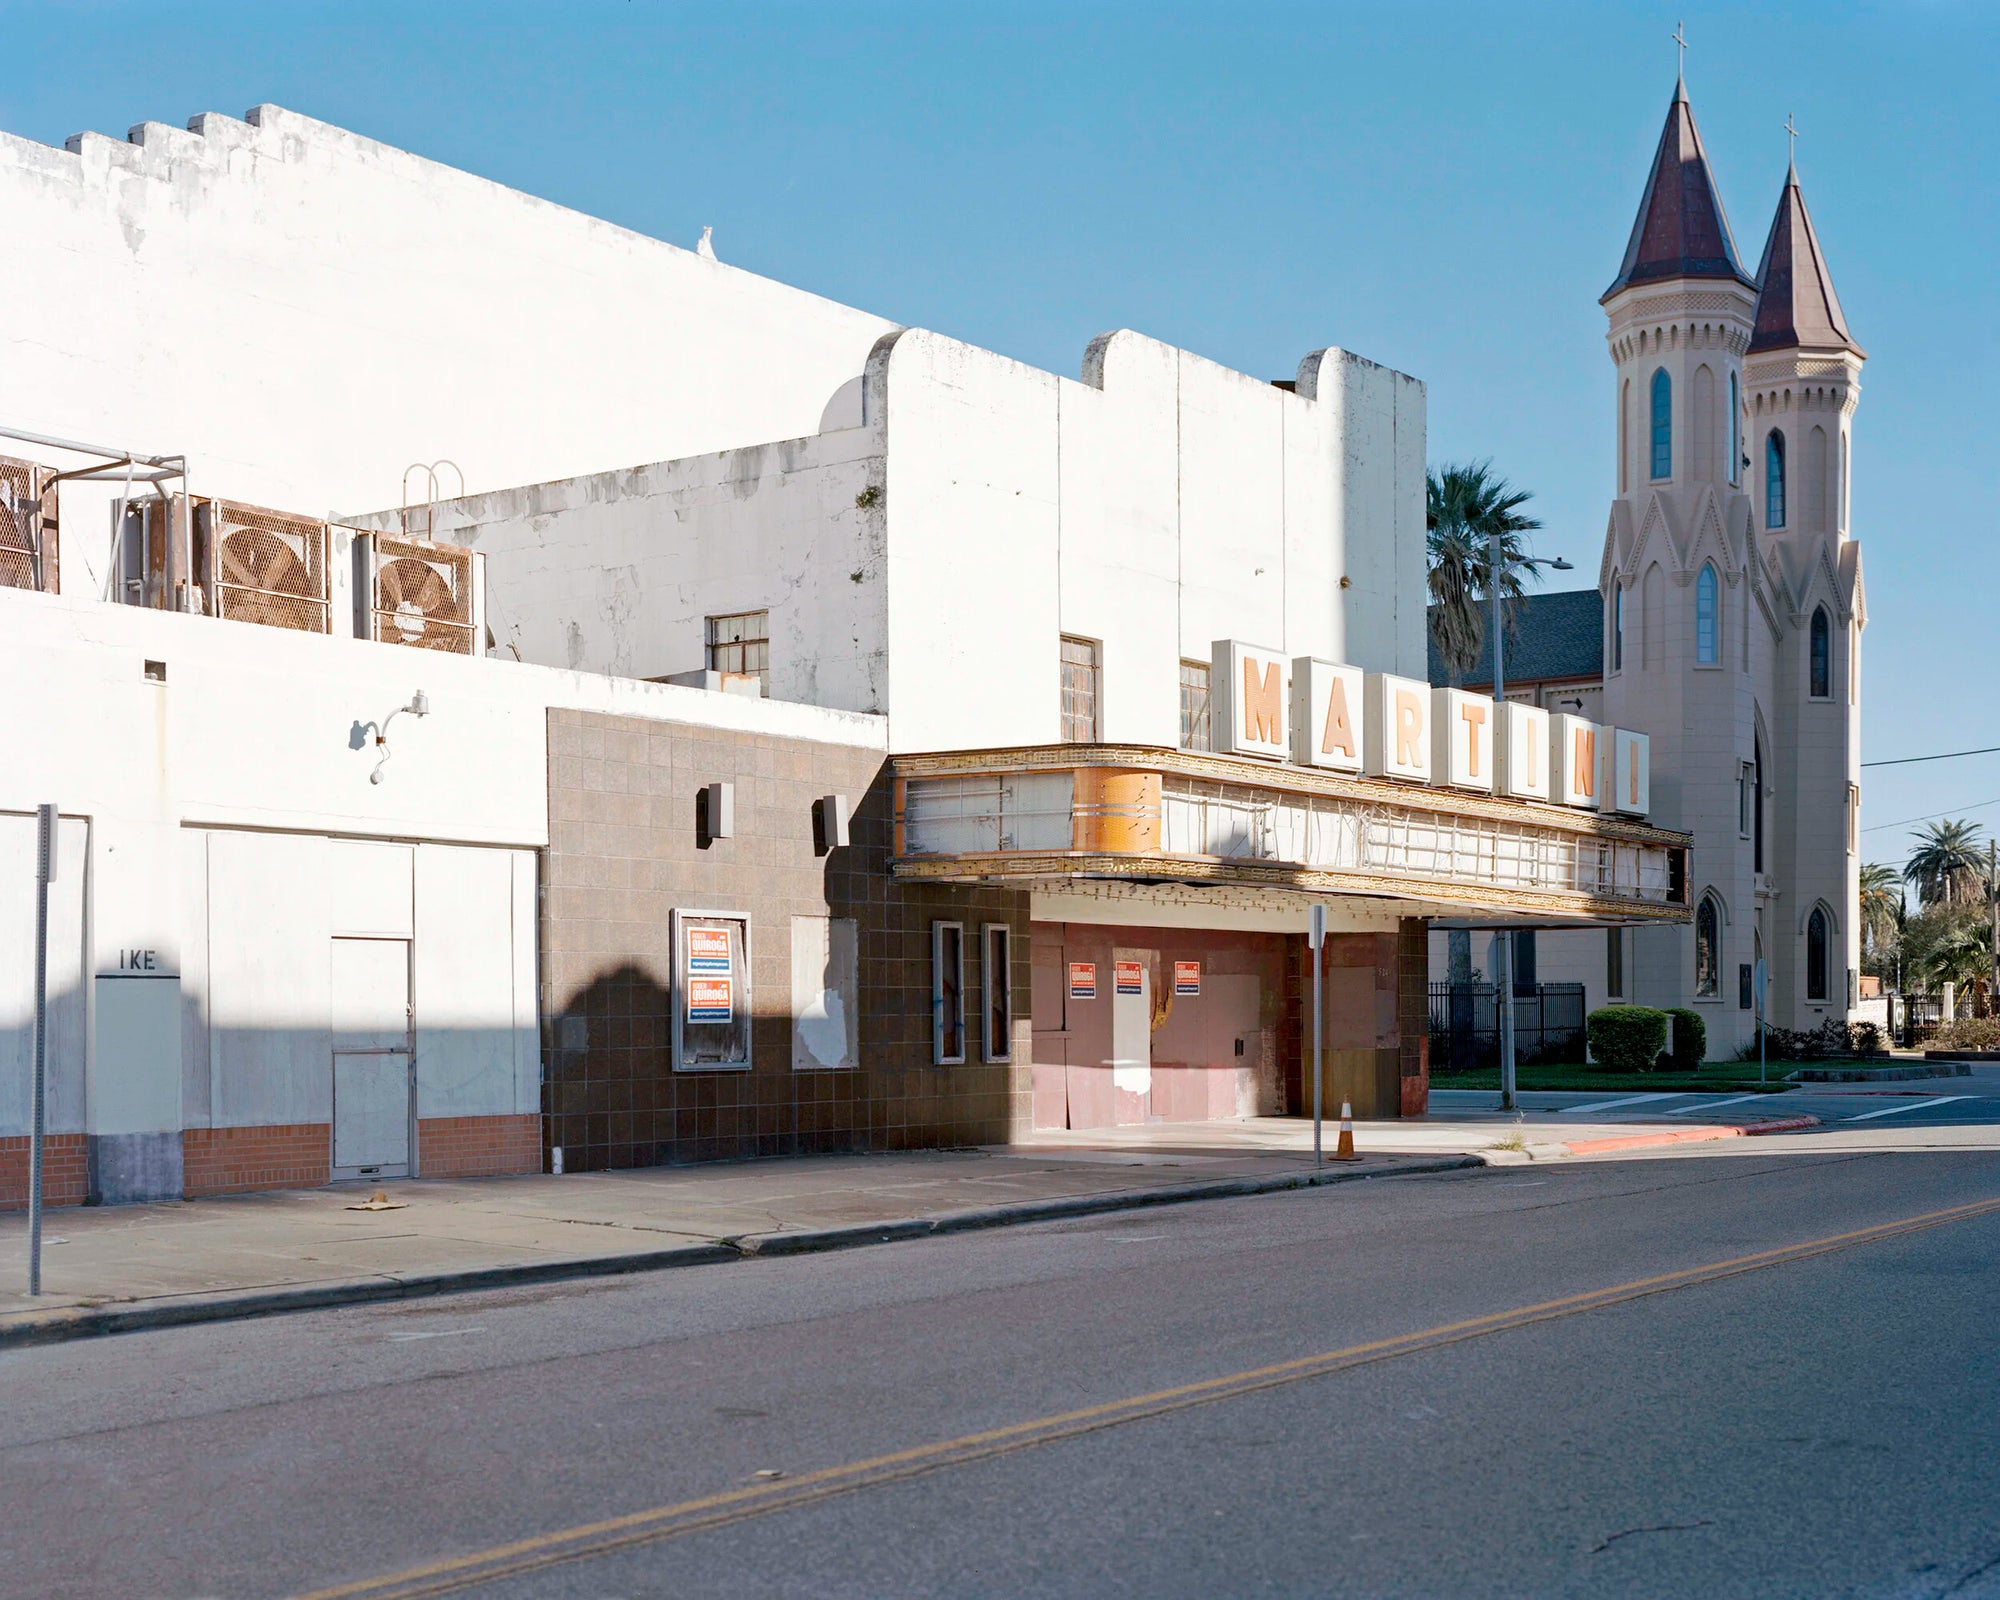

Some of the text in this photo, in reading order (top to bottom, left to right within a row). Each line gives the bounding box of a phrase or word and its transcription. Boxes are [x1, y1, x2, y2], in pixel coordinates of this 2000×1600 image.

[1244, 656, 1639, 805] MARTINI
[692, 939, 728, 951] QUIROGA
[120, 949, 155, 970] IKE
[692, 989, 729, 1002] QUIROGA
